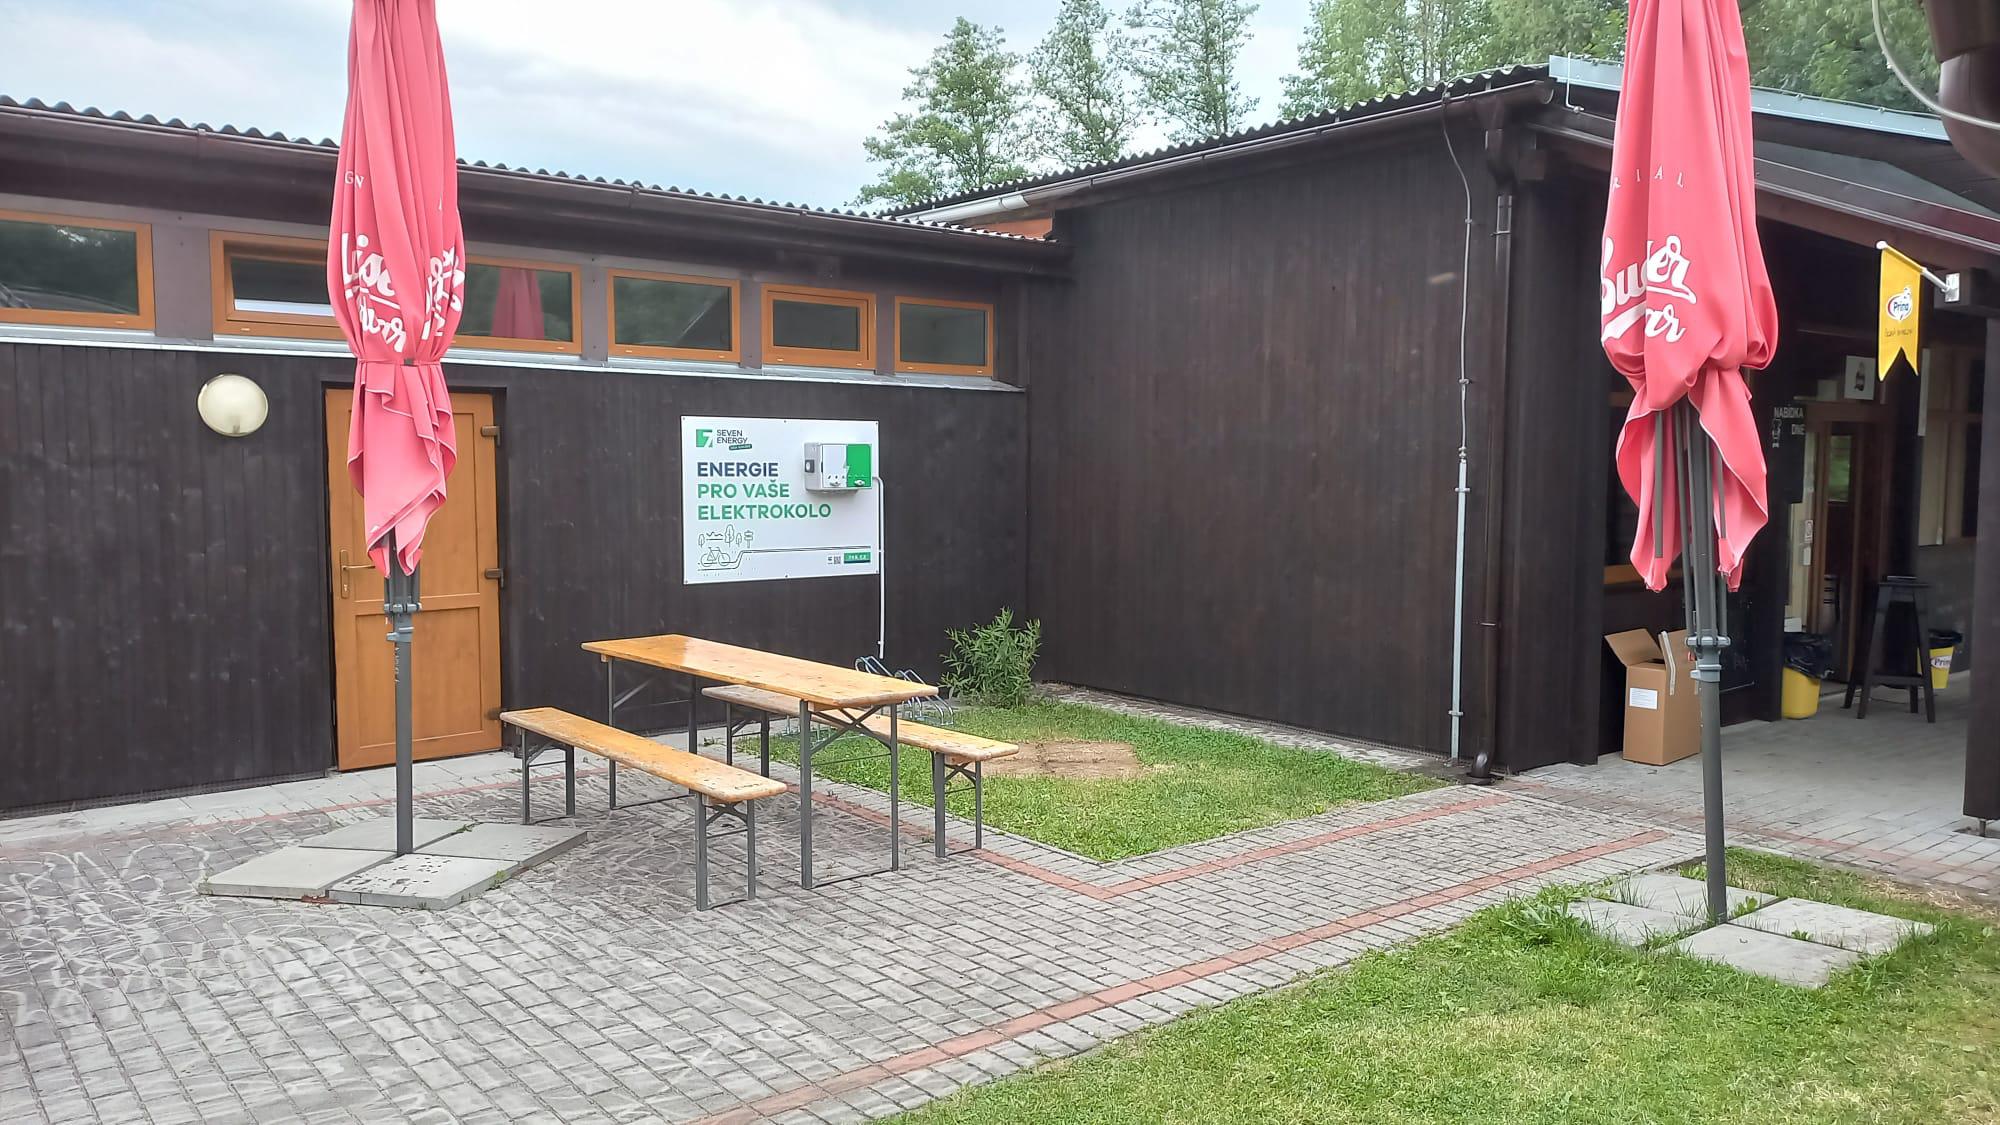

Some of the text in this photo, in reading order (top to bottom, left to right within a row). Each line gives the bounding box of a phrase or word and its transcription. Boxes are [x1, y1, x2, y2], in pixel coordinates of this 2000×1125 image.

[716, 429, 743, 437] SEVEN
[697, 462, 779, 477] ENERGIE
[697, 479, 790, 498] PRO VAŠE
[697, 503, 832, 520] ELEKTROKOLO
